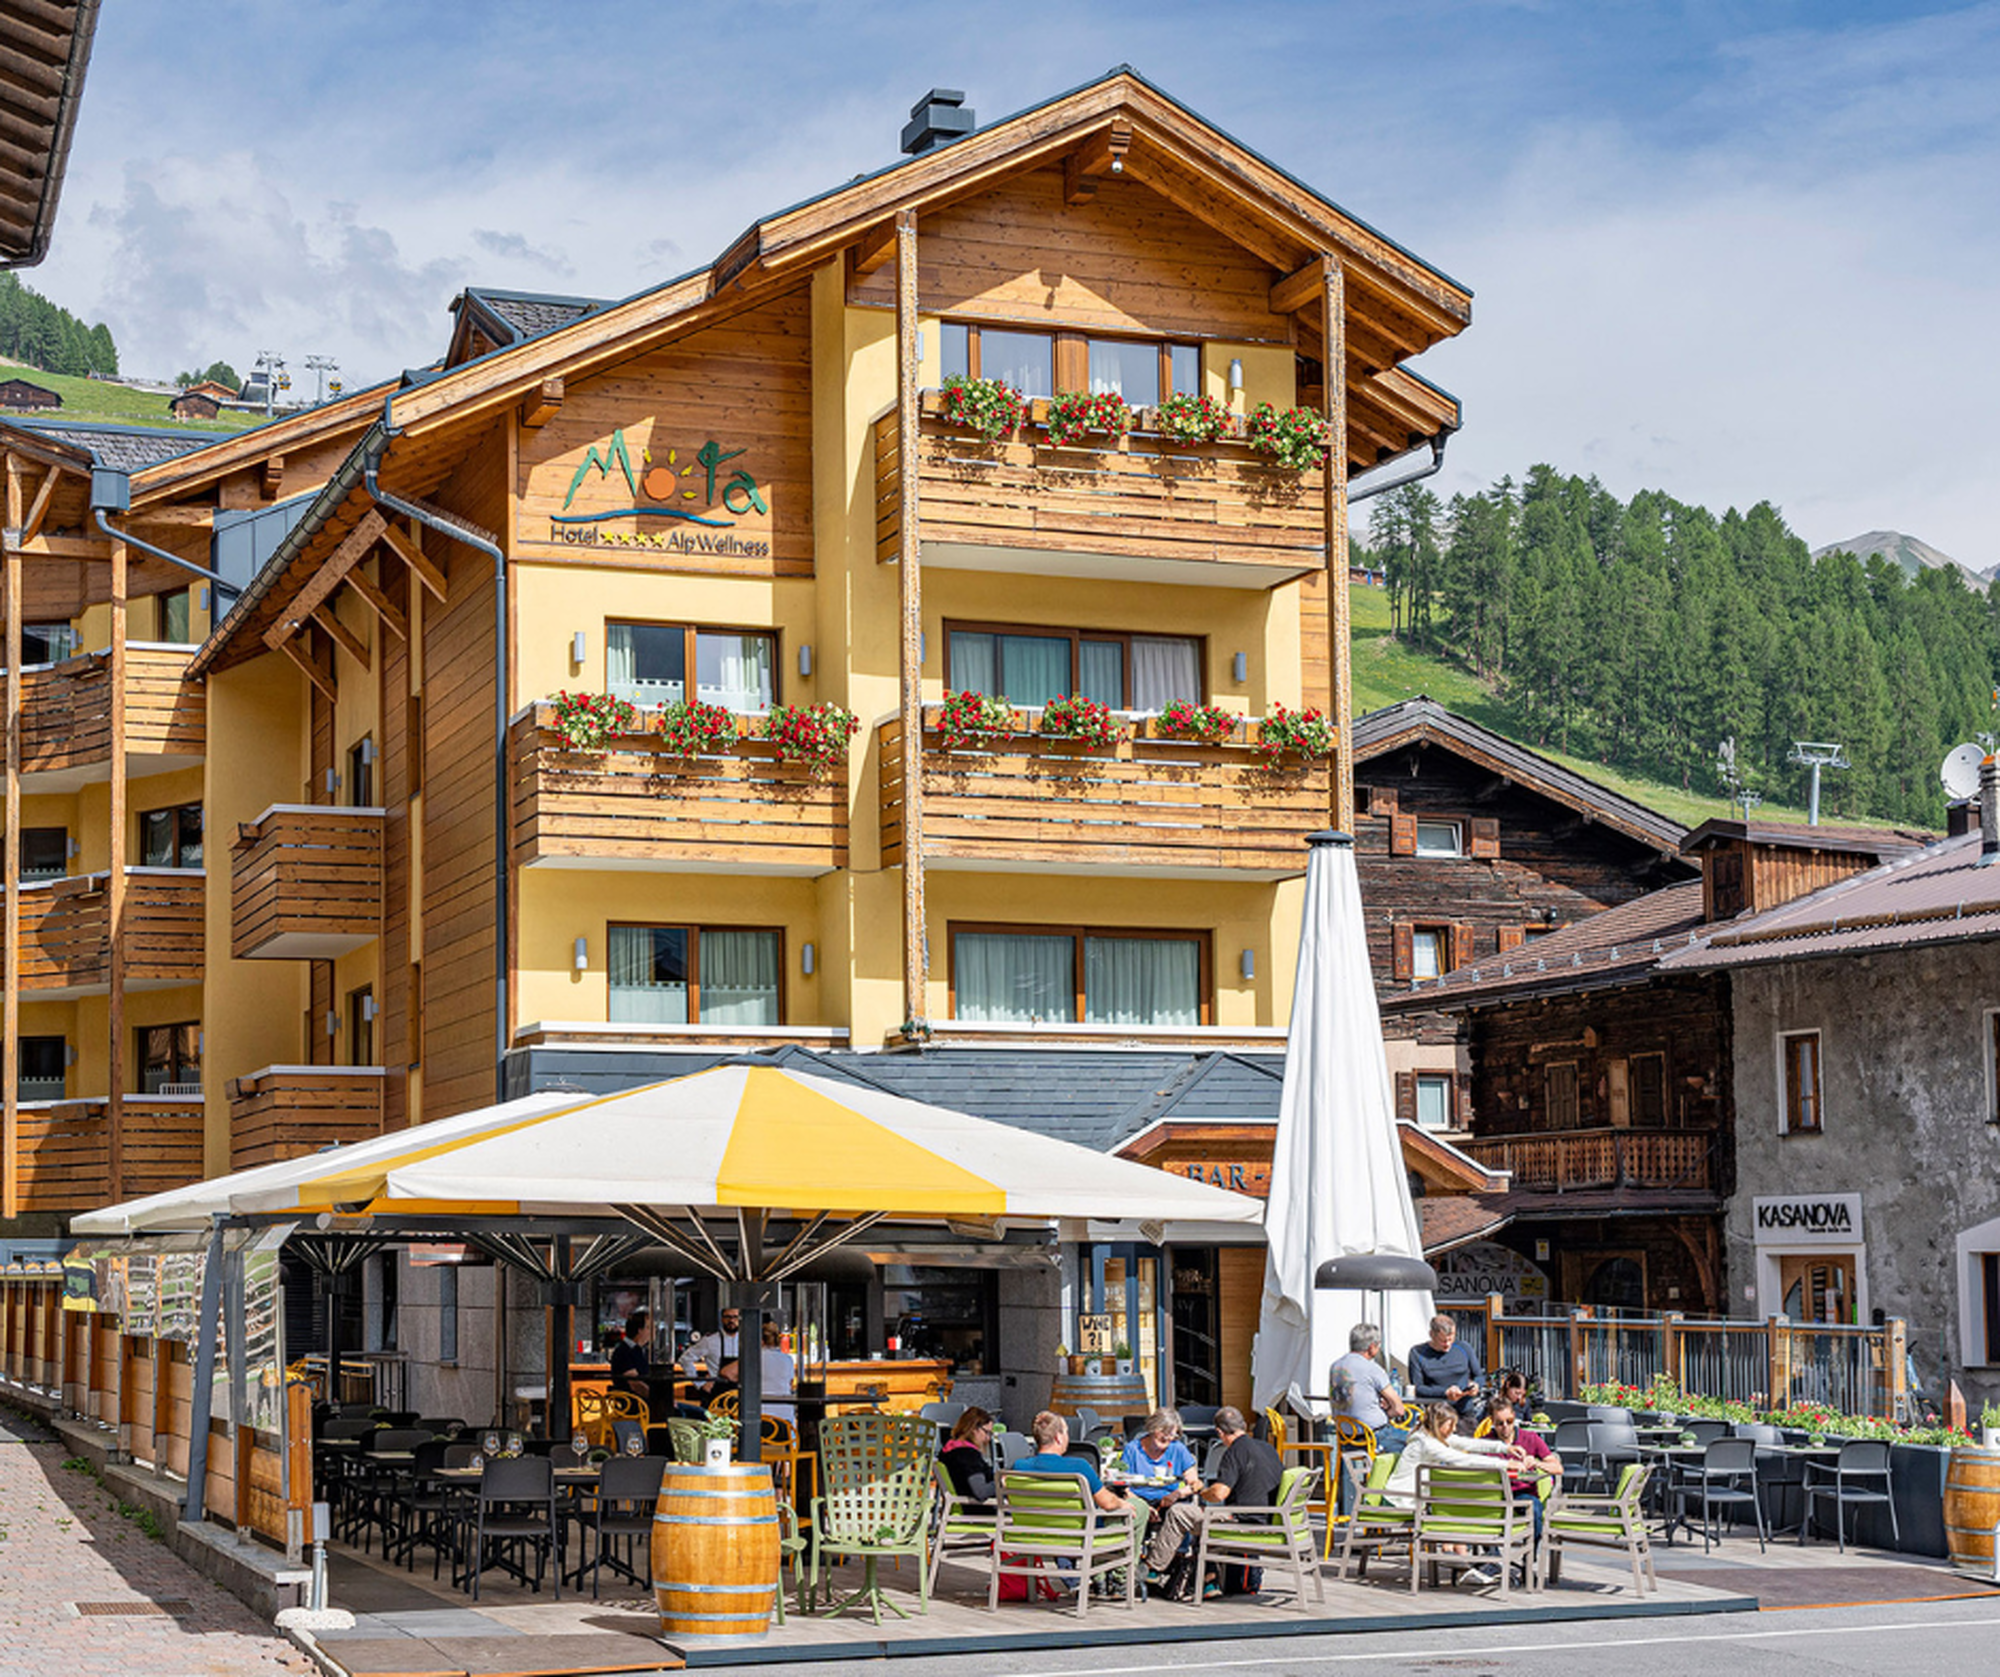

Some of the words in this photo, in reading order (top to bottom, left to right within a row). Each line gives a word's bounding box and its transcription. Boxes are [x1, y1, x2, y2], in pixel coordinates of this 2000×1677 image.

[551, 524, 598, 545] Hotel
[1188, 1163, 1247, 1189] BAR
[1759, 1203, 1851, 1228] KASANOVA
